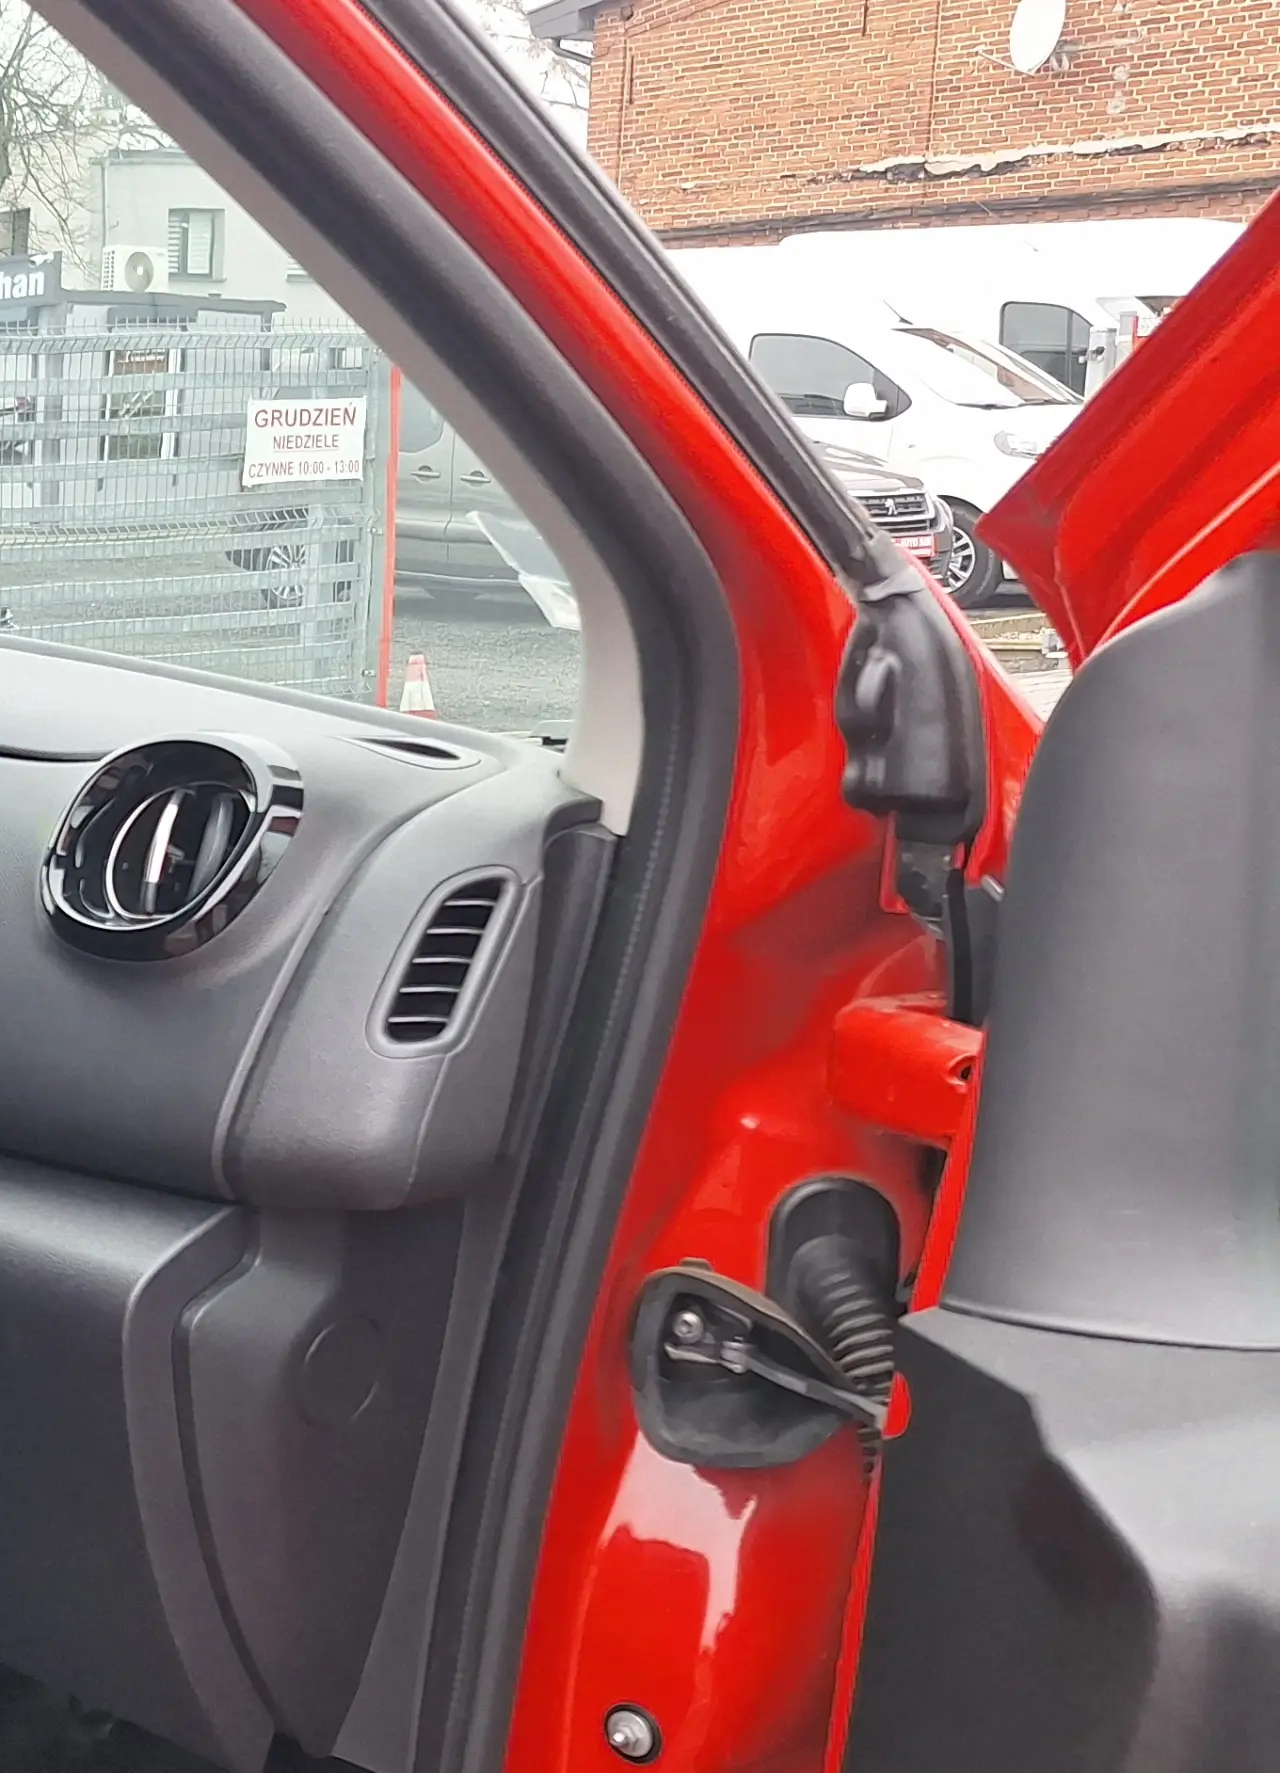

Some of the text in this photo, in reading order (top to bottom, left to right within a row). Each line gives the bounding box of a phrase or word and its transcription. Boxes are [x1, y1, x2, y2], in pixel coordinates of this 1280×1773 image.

[254, 401, 357, 428] GRUDZIEŃ
[272, 433, 340, 450] NIEDZIELE
[248, 461, 294, 478] CZYNNE
[298, 460, 324, 475] 10:00
[335, 459, 360, 474] 13:00
